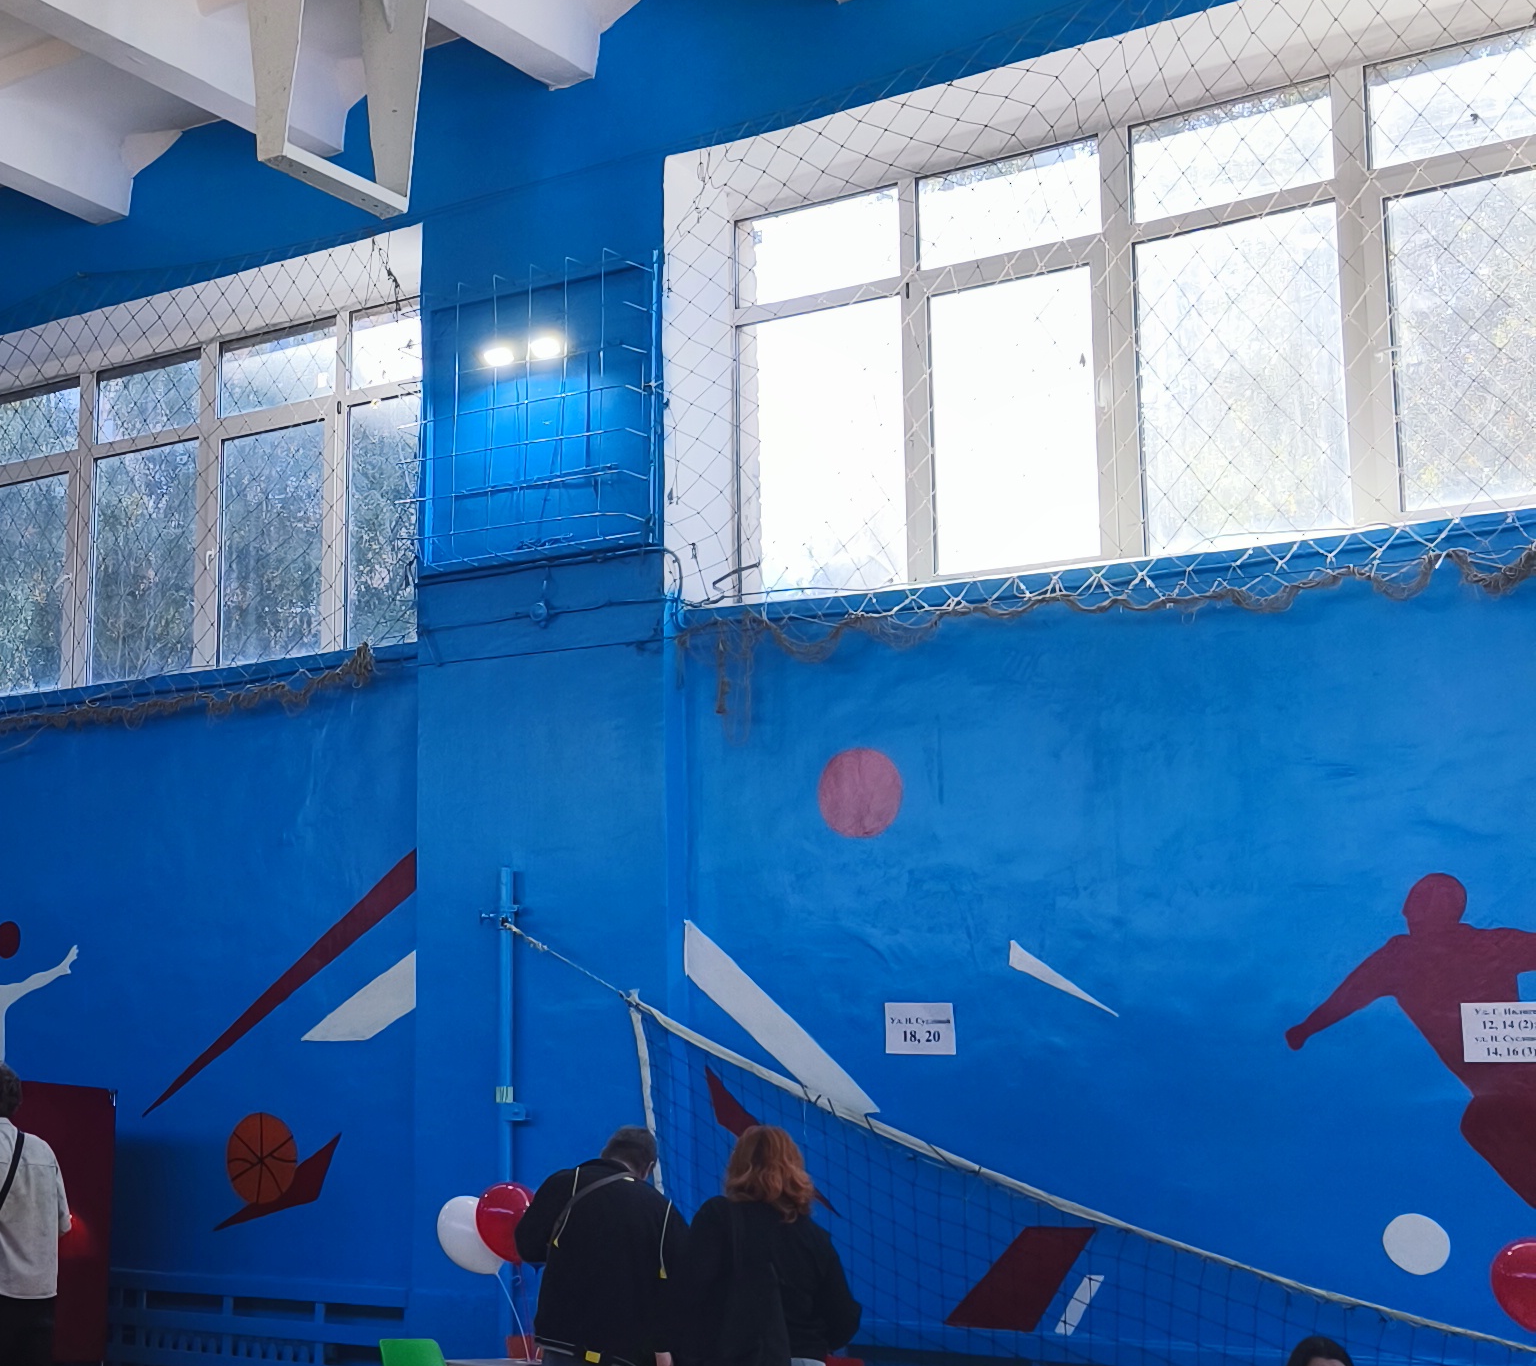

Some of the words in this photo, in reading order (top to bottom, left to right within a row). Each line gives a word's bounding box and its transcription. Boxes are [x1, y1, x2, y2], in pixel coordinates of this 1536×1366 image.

[1503, 1020, 1515, 1030] 14
[903, 1029, 921, 1044] 18,
[925, 1030, 941, 1043] 20
[1507, 1046, 1519, 1057] 16
